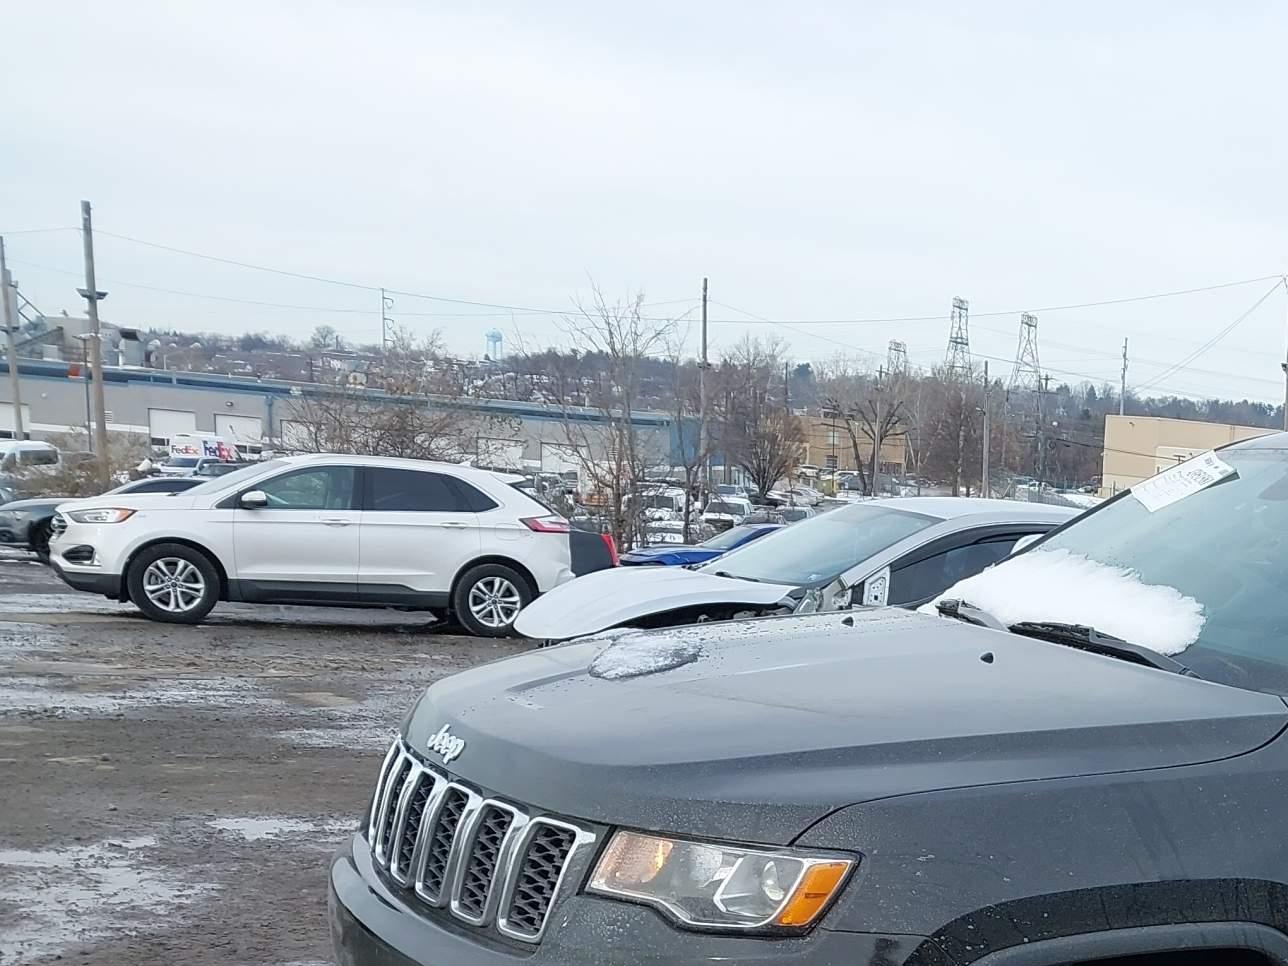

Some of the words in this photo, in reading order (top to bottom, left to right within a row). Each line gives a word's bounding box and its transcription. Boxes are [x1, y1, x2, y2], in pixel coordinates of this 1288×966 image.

[171, 445, 199, 455] FedEx
[203, 440, 233, 459] FedEx
[427, 724, 465, 765] Jeep
